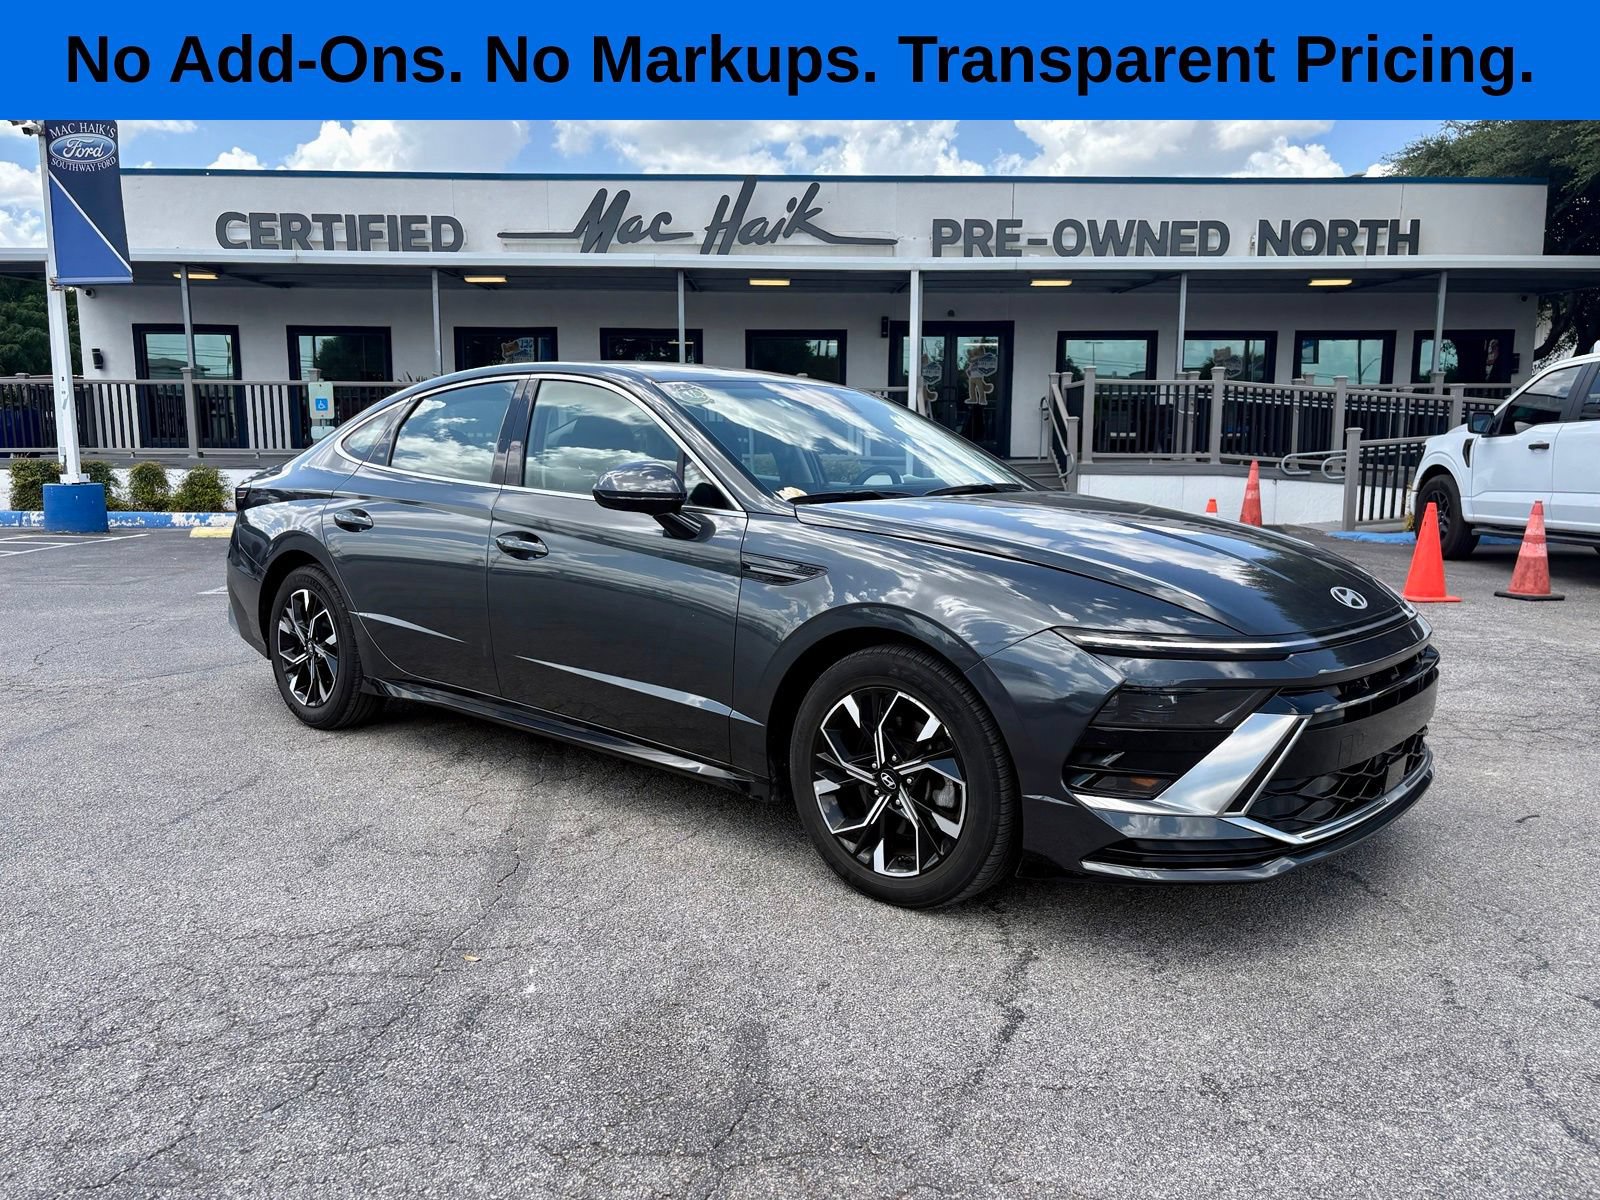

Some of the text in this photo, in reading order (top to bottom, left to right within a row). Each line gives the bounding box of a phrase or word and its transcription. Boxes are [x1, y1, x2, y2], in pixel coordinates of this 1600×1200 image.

[50, 122, 116, 138] MAC HAIK'S
[63, 137, 104, 158] Ford
[51, 156, 116, 172] SOUTHWAY FORD
[216, 176, 1420, 256] CERTIFIED Mac Haik PRE-OWNED NORTH
